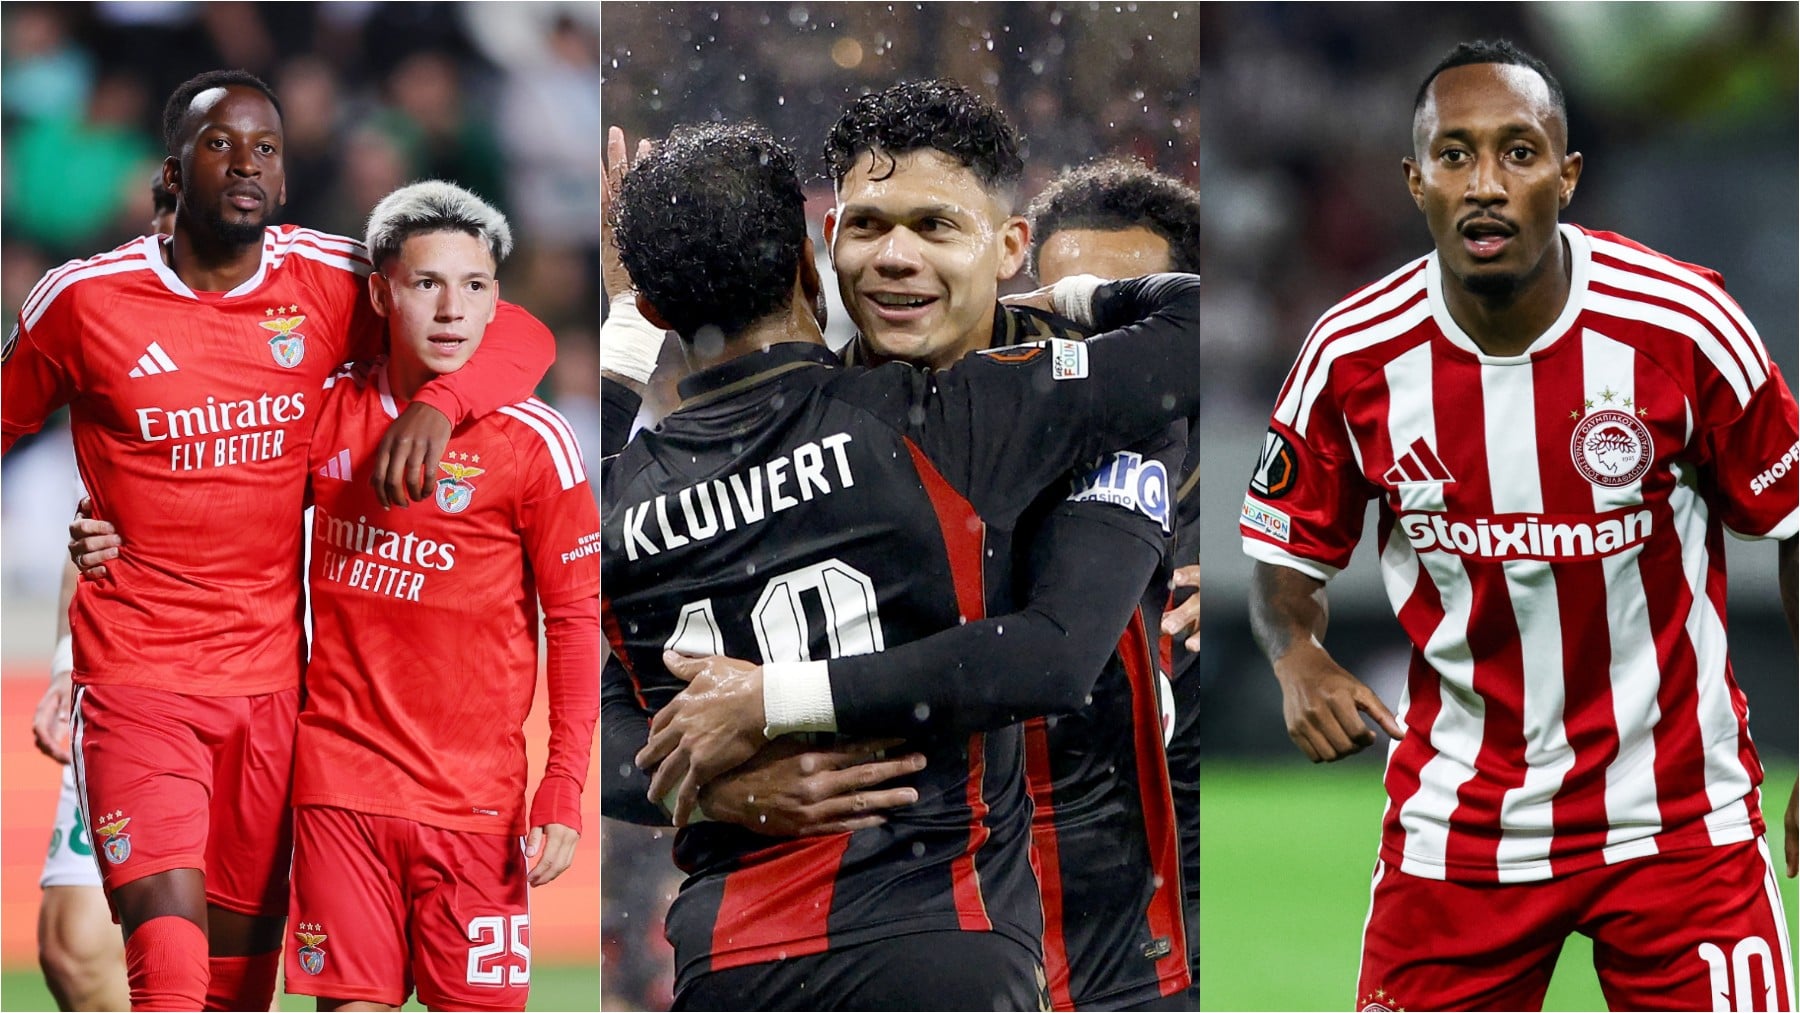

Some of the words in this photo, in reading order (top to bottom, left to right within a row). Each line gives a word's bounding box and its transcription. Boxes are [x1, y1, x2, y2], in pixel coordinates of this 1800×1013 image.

[136, 392, 305, 442] Emirates
[171, 441, 206, 472] FLY
[214, 429, 285, 467] BETTER
[623, 432, 854, 562] KLUIVERT
[315, 504, 456, 572] Emirates
[1400, 509, 1653, 557] stoiximan
[322, 551, 348, 583] FLY
[348, 558, 425, 602] BETTER
[466, 914, 531, 988] 25
